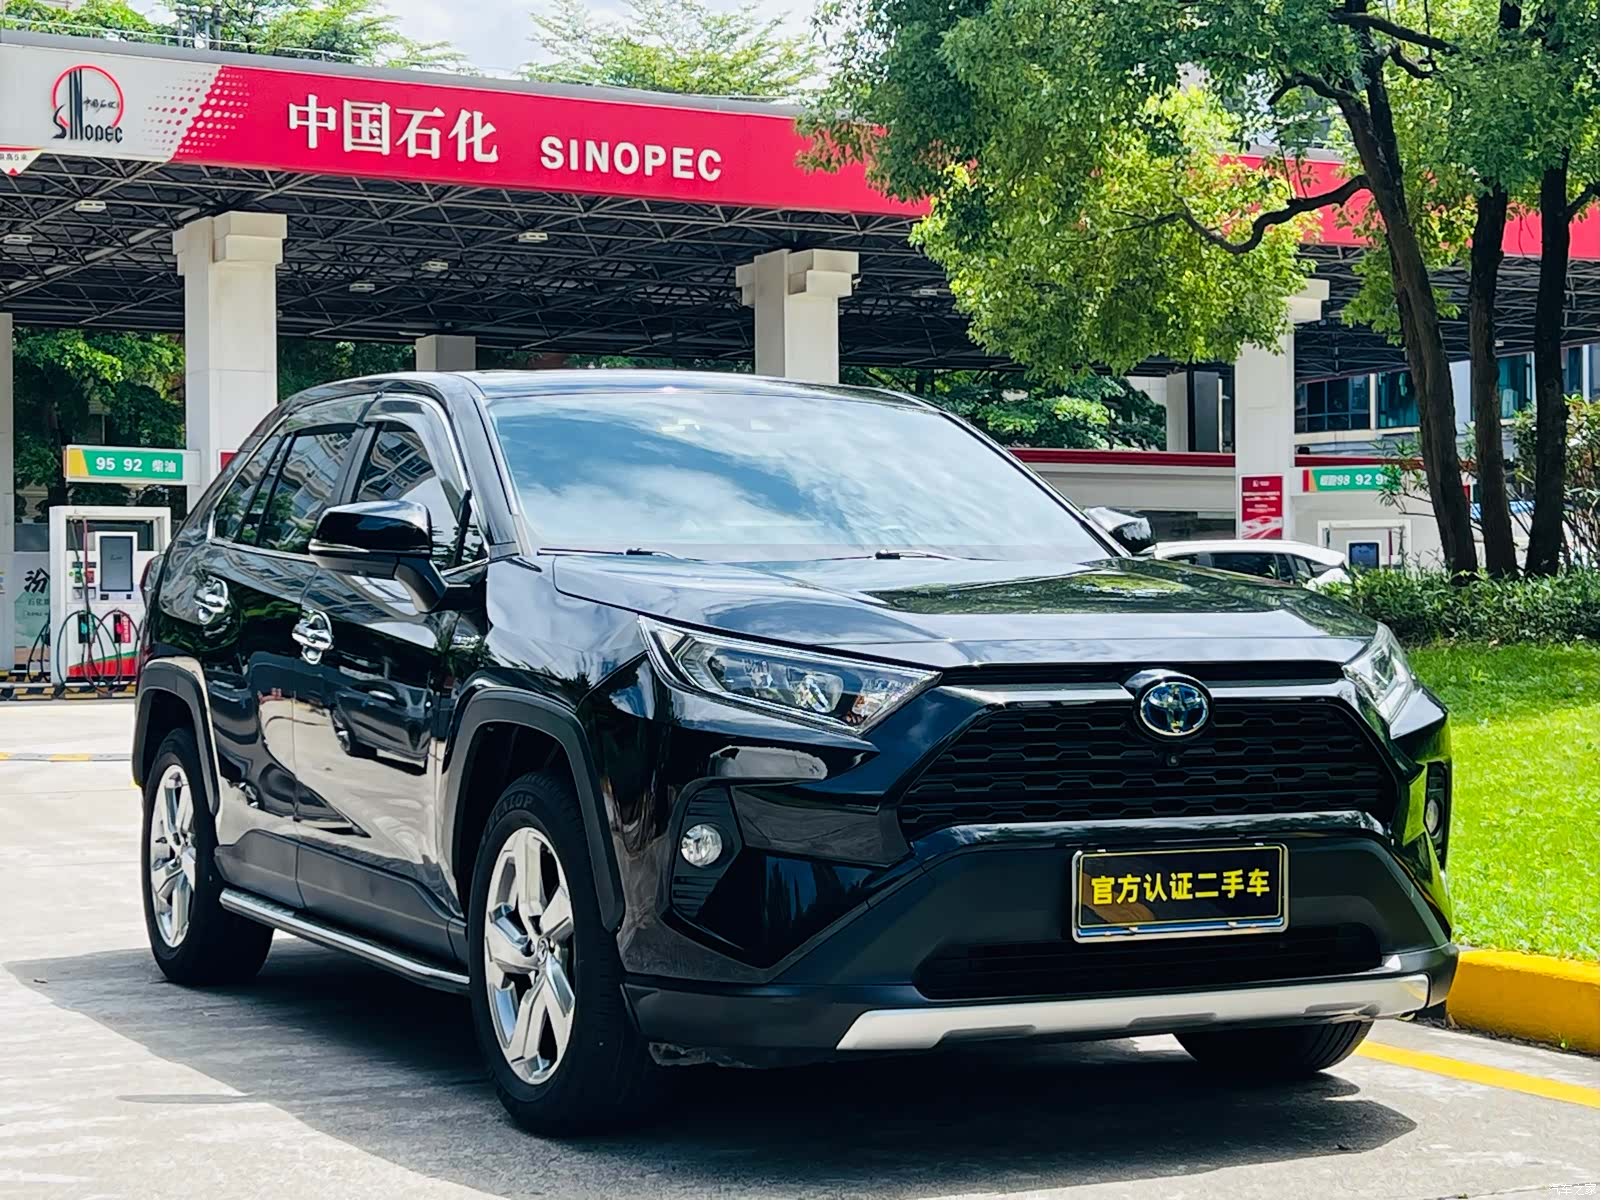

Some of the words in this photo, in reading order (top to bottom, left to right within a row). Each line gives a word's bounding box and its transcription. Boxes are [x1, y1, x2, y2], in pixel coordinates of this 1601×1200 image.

[288, 94, 499, 163] 中国石化
[540, 136, 722, 182] SINOPEC
[95, 457, 116, 471] 95
[123, 458, 143, 472] 92
[152, 460, 177, 473] 柴油
[1355, 474, 1372, 486] 92
[1091, 868, 1270, 905] 官方认证二手车
